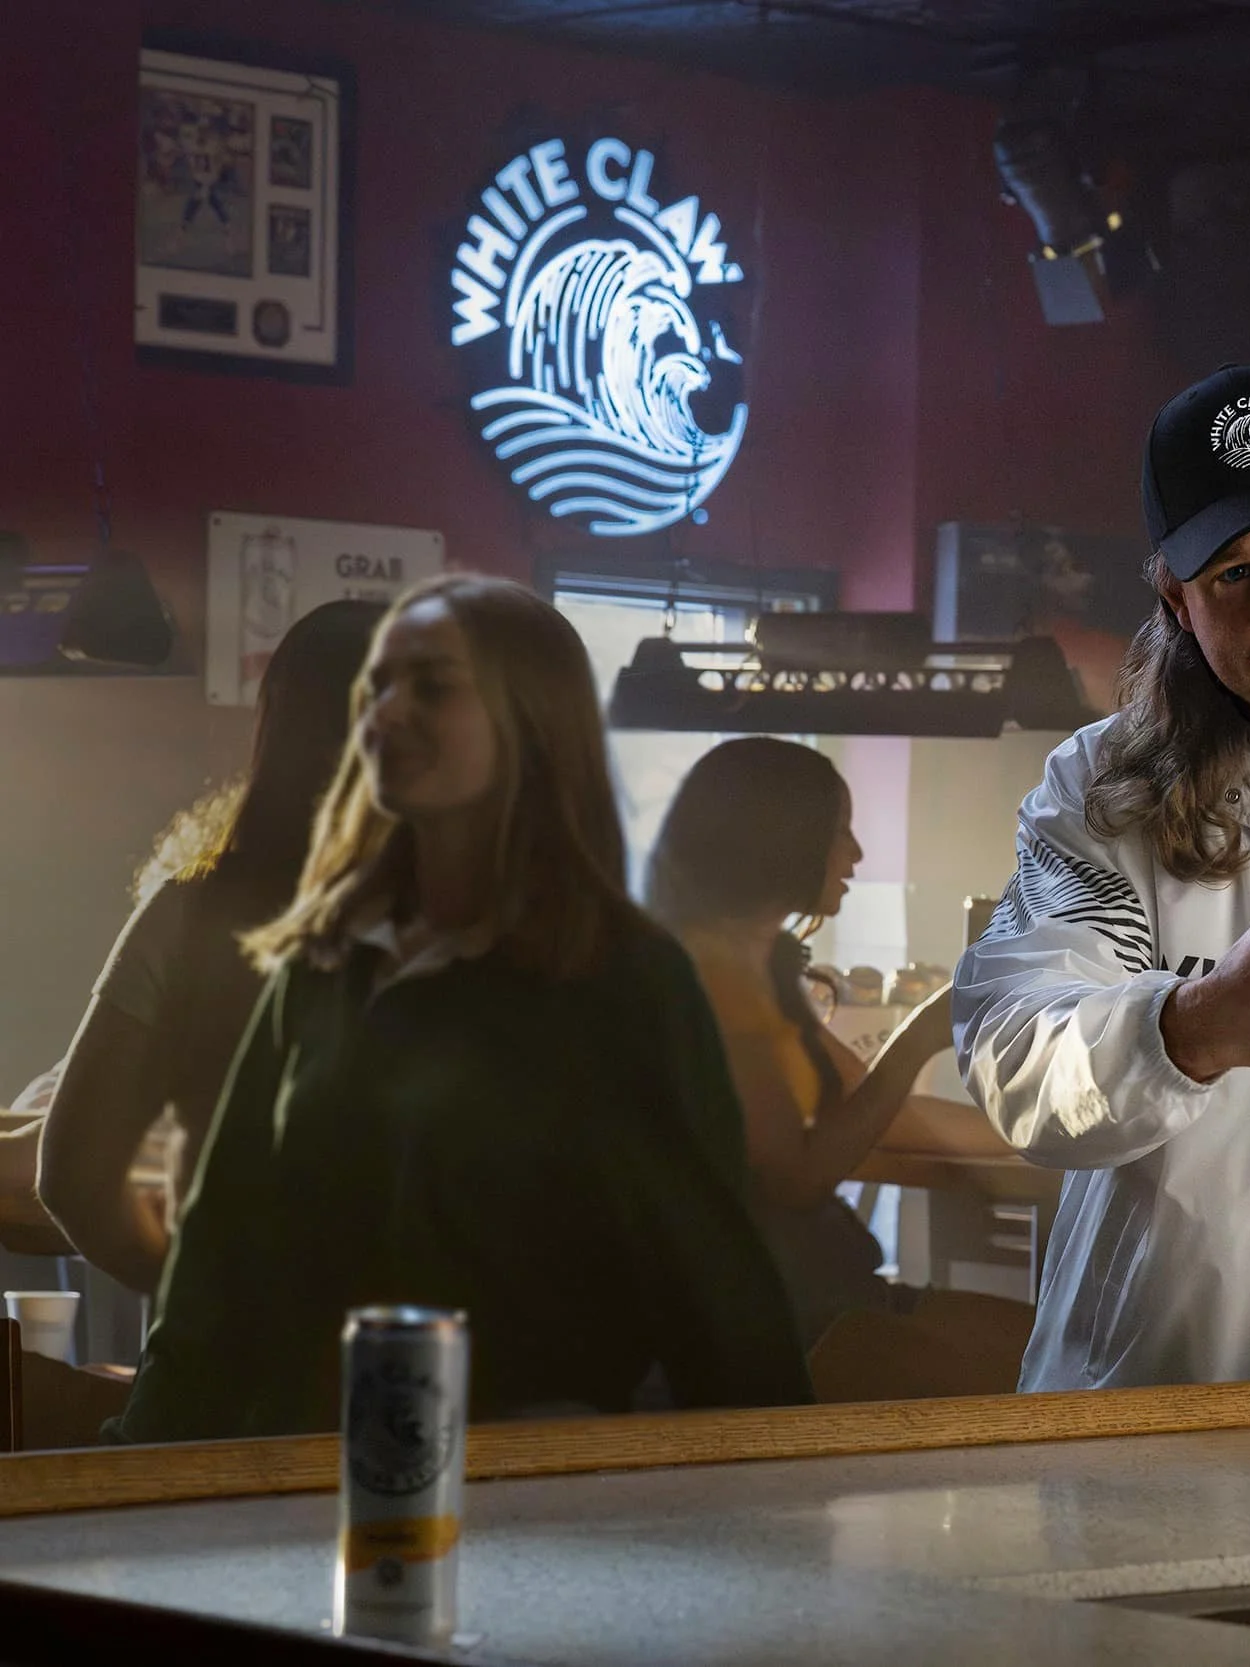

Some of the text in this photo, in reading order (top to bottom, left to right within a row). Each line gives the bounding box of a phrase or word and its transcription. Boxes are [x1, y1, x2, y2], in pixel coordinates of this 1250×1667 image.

[451, 137, 744, 346] WHITE CLAW
[1210, 404, 1235, 451] WHITE
